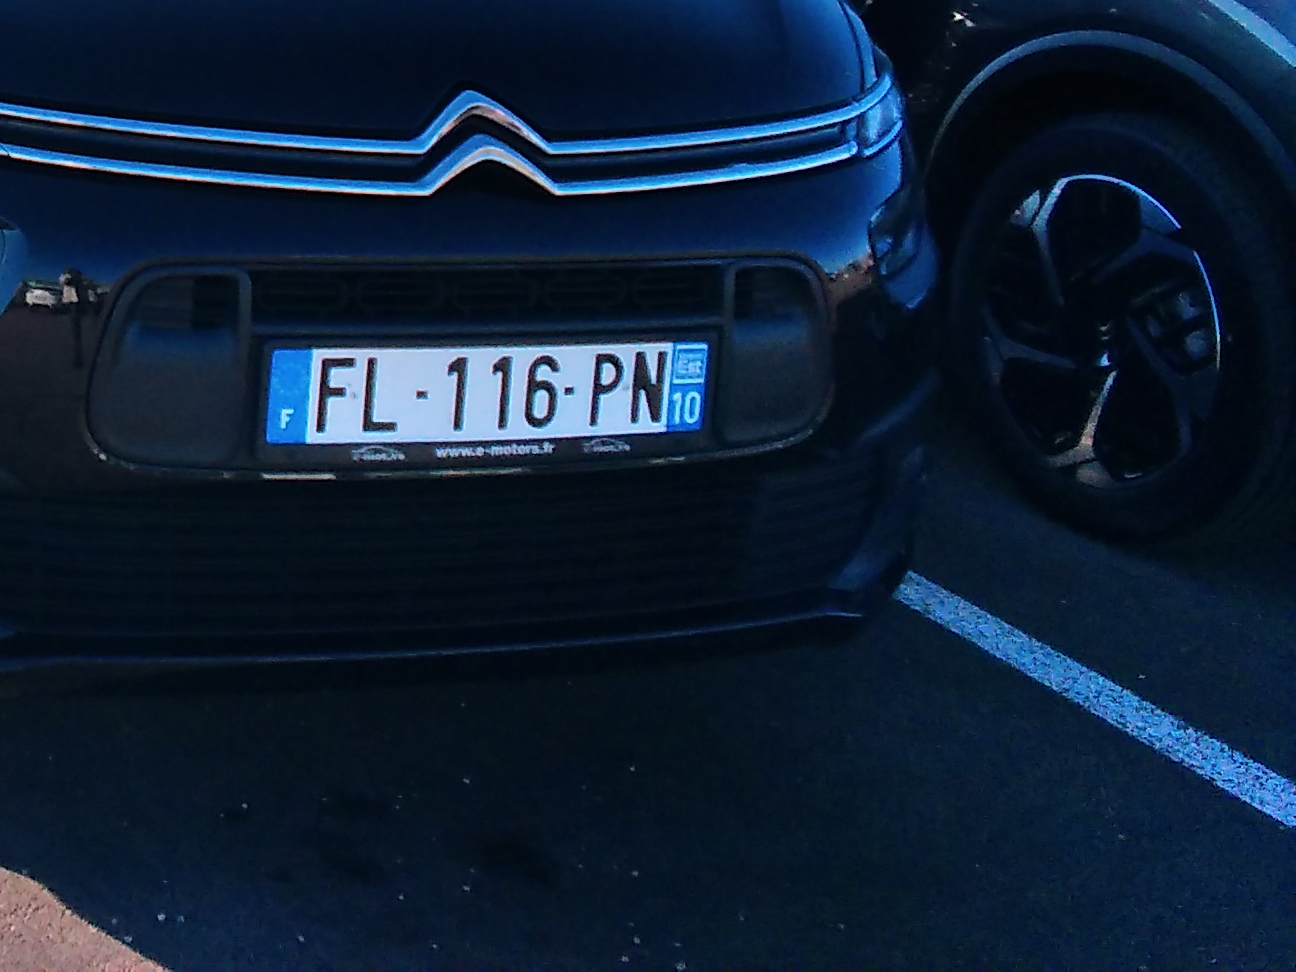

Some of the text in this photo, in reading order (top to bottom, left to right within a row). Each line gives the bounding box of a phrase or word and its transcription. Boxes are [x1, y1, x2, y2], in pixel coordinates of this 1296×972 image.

[673, 391, 701, 424] 10
[280, 408, 294, 429] F
[435, 441, 556, 458] www.e-motors.fr
